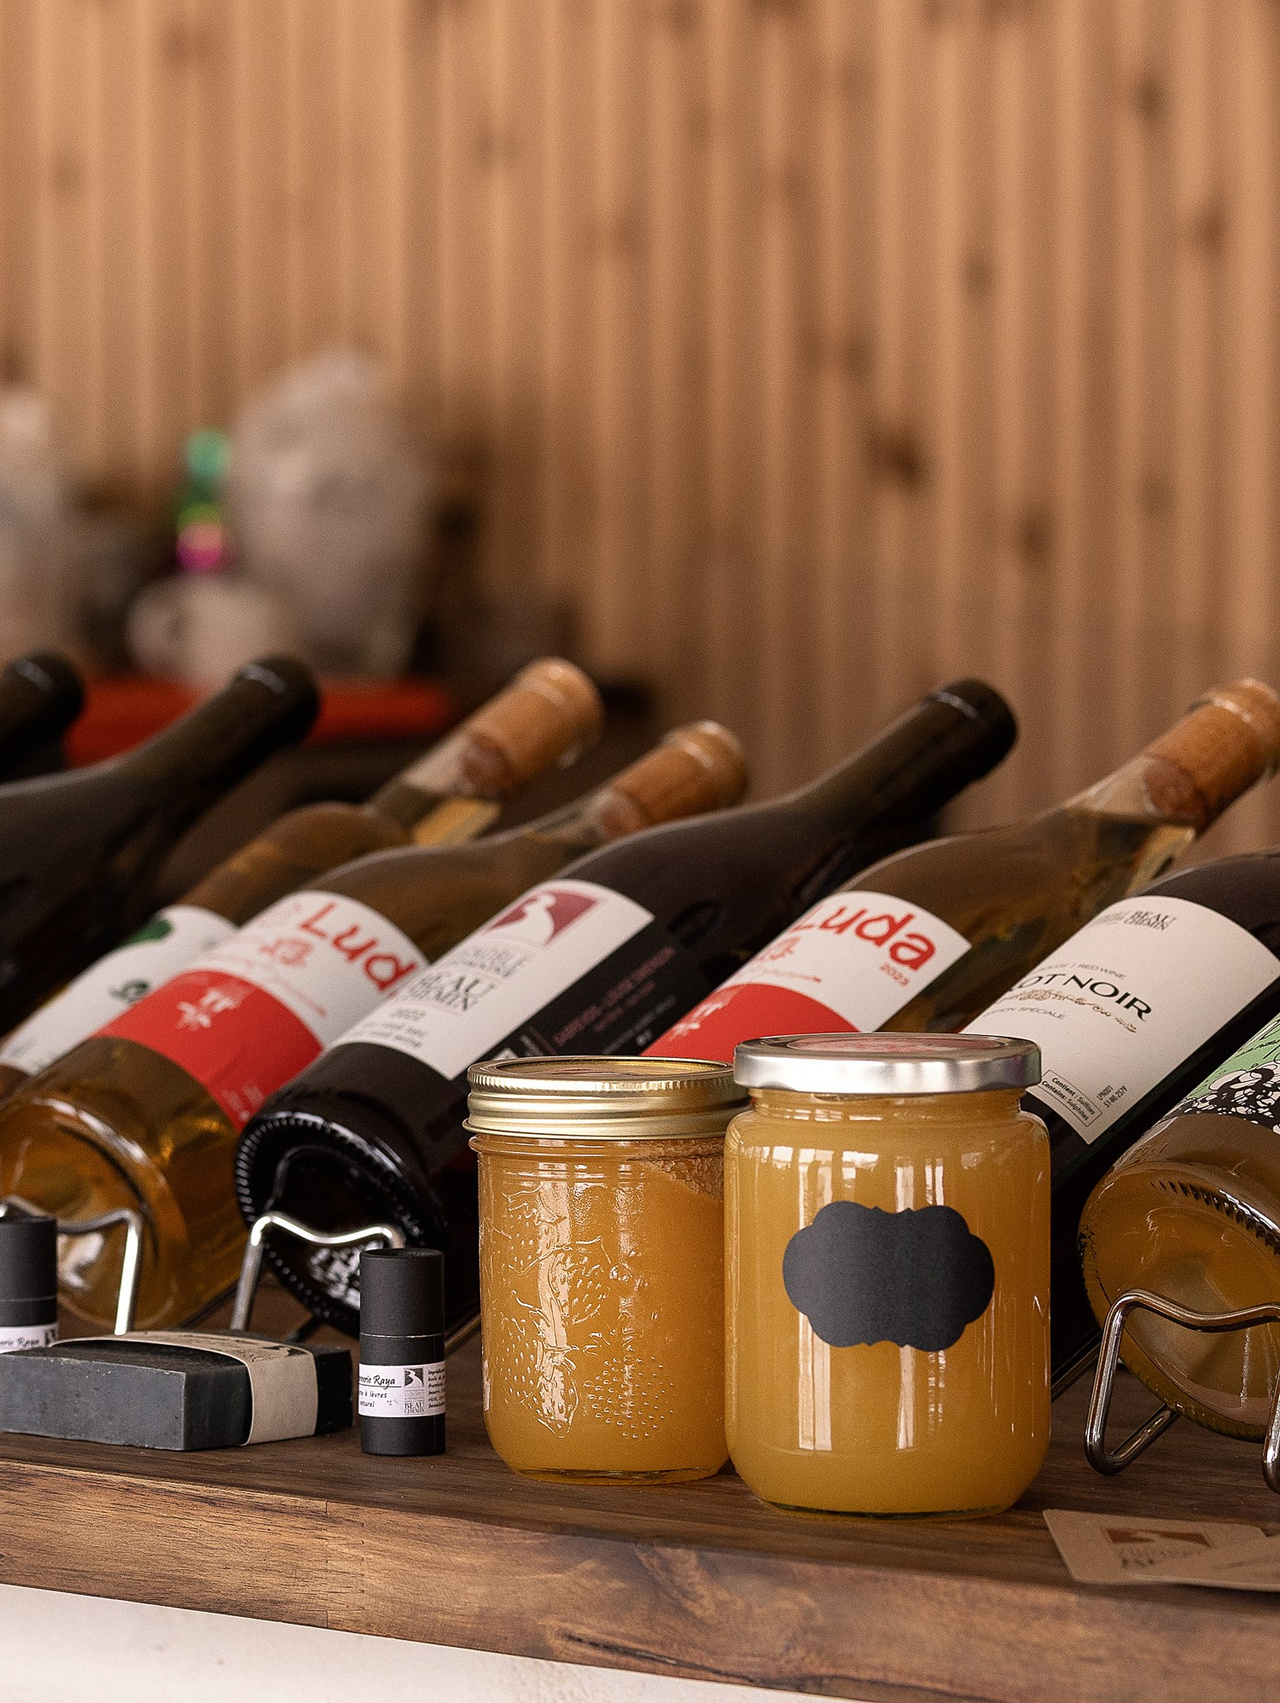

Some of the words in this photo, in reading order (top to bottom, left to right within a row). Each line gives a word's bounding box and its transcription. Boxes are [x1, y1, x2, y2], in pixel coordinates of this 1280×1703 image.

[298, 901, 418, 992] Lud
[1062, 974, 1153, 1022] NOIR
[1041, 1080, 1067, 1101] Contains:
[1067, 1098, 1089, 1121] Sulphites
[1077, 1096, 1096, 1115] Sulfites
[373, 1375, 396, 1390] Raya
